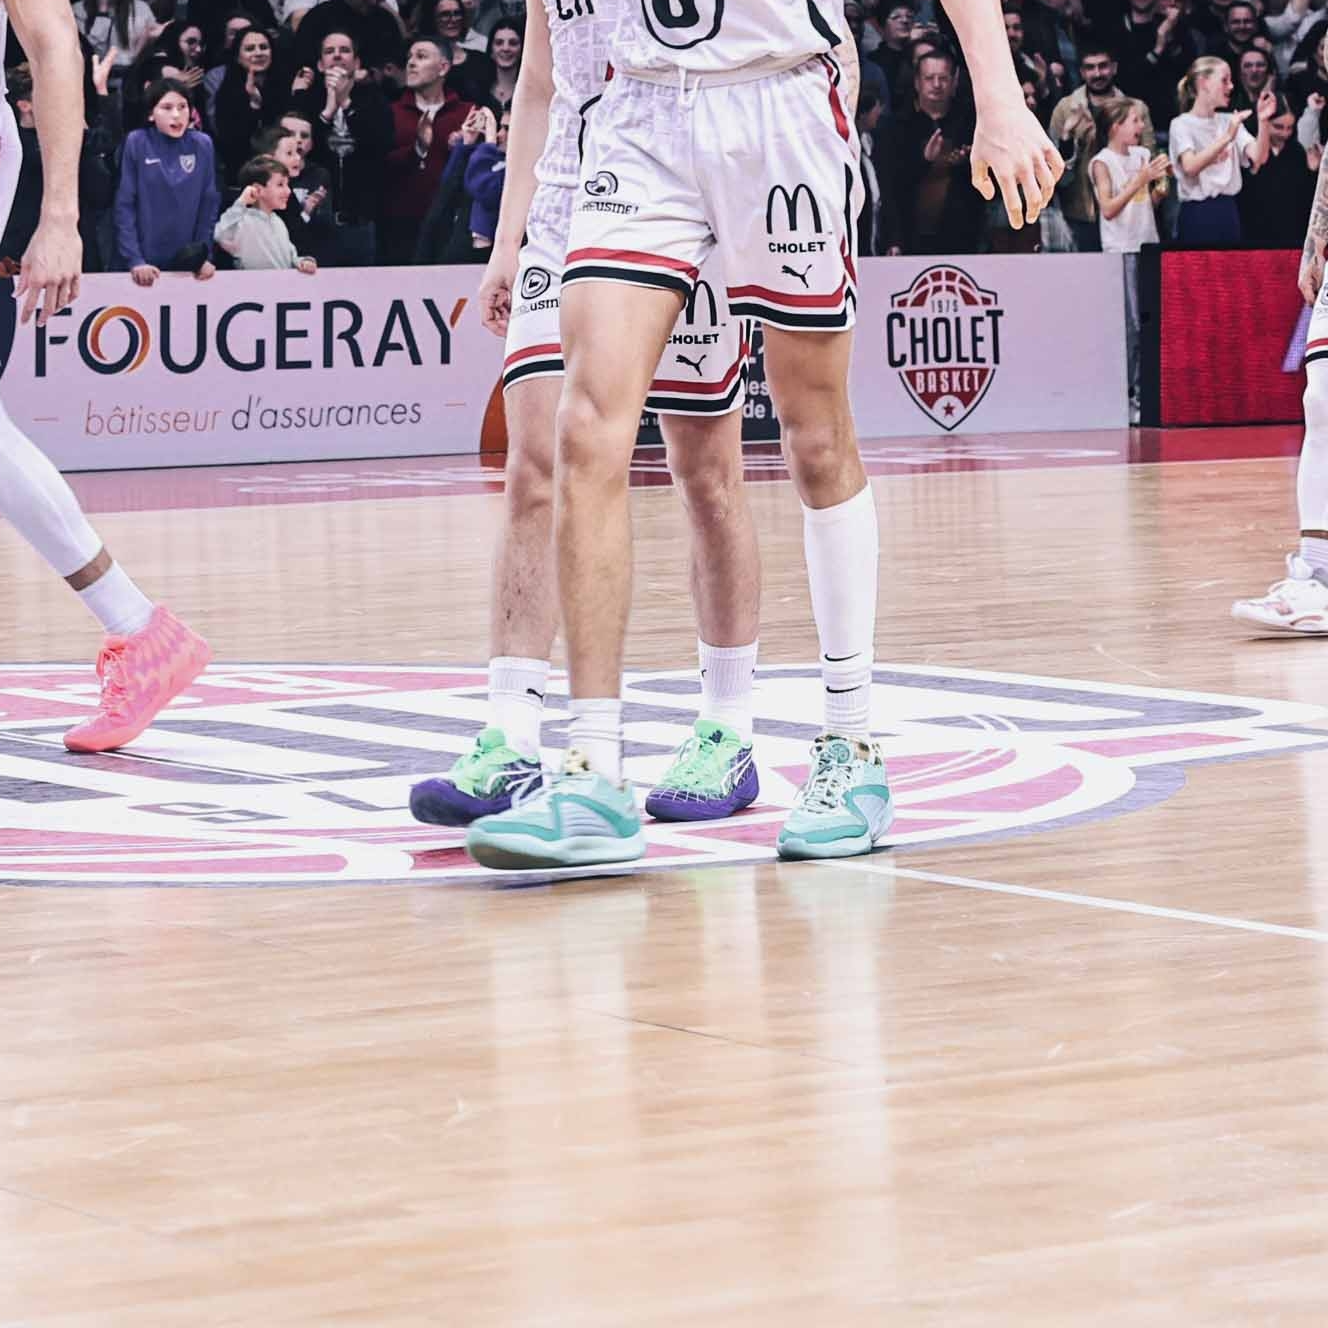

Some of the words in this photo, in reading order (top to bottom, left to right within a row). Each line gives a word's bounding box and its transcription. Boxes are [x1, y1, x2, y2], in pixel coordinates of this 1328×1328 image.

[769, 241, 826, 253] CHOLET
[35, 296, 469, 378] FOUGERAY
[886, 309, 1004, 368] CHOLET
[916, 369, 980, 394] BASKET
[85, 401, 223, 436] bâtisseur
[231, 395, 422, 431] d'assurances
